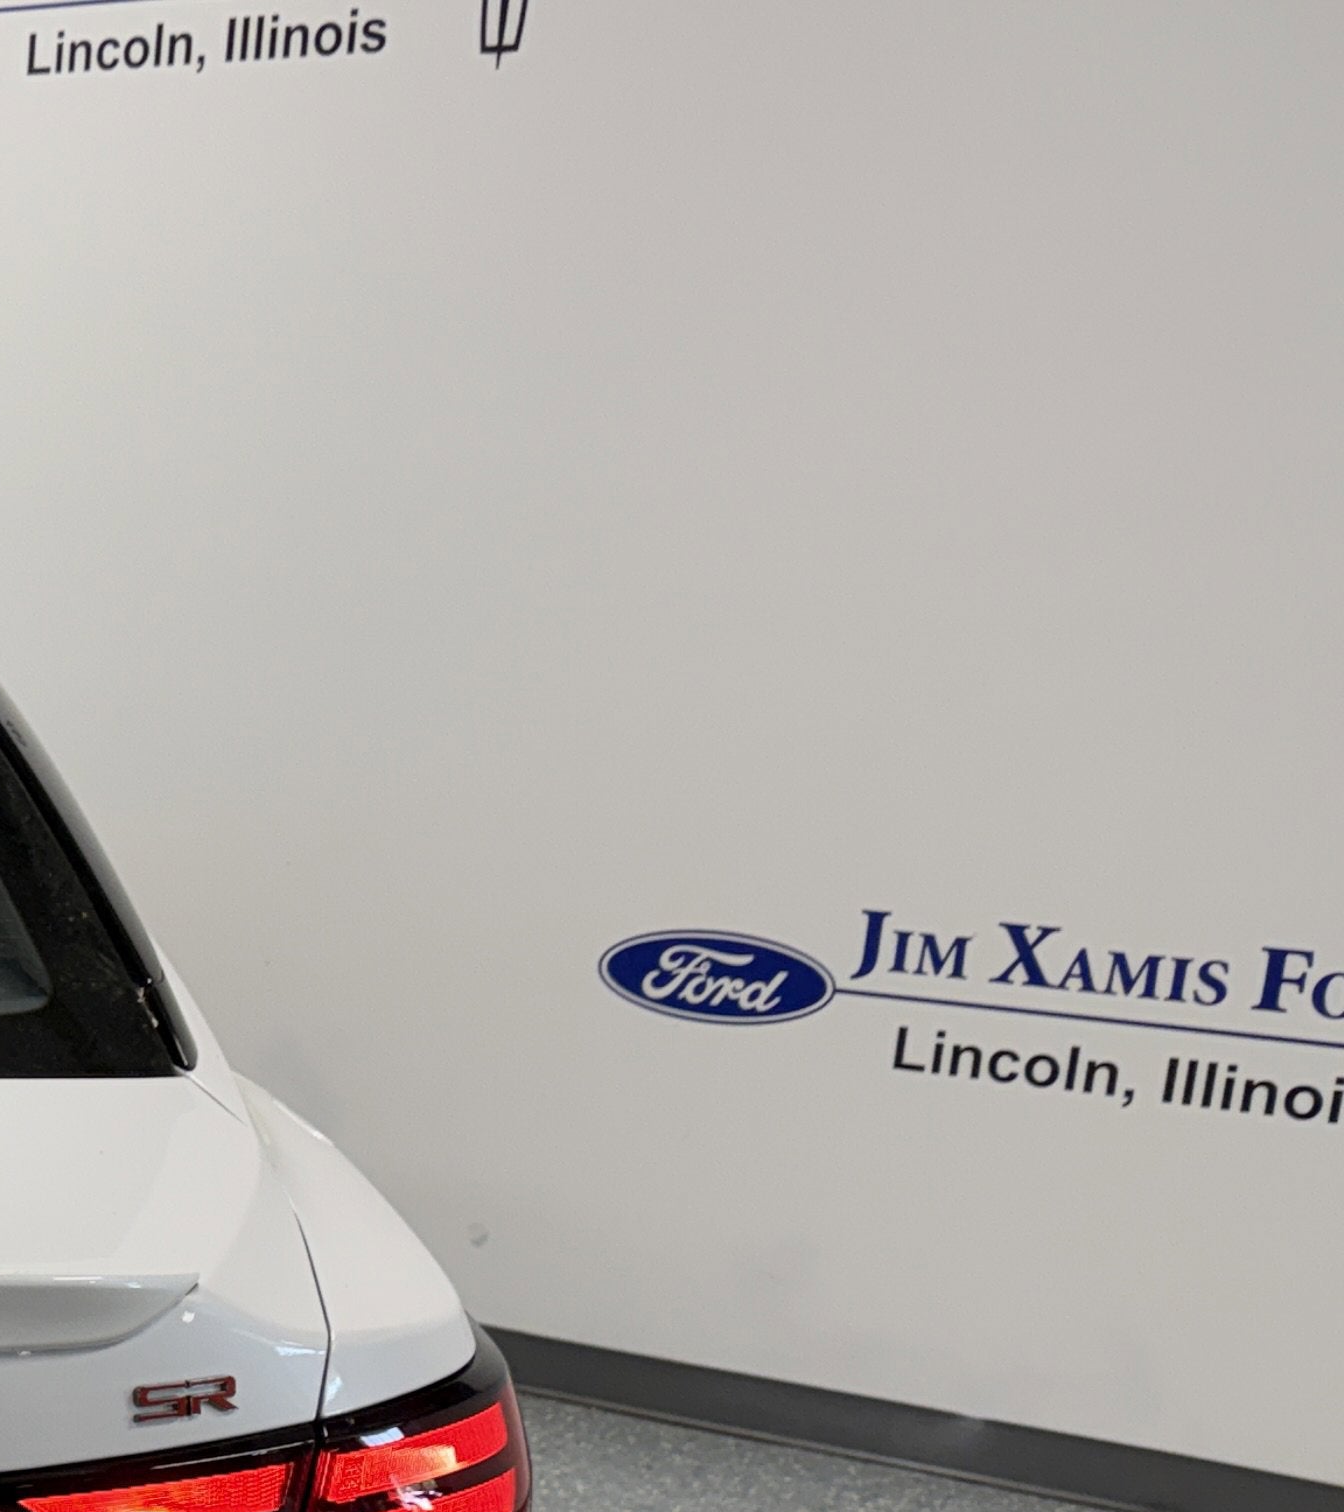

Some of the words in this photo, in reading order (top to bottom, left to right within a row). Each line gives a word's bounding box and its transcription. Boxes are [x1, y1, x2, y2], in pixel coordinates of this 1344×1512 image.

[27, 23, 207, 76] Lincoln,
[223, 9, 388, 64] Illinois
[640, 944, 784, 1014] Ford
[848, 908, 972, 981] JIM
[988, 921, 1231, 1007] XAMIS
[891, 1025, 1138, 1107] Lincoln,
[131, 1375, 240, 1424] SR
